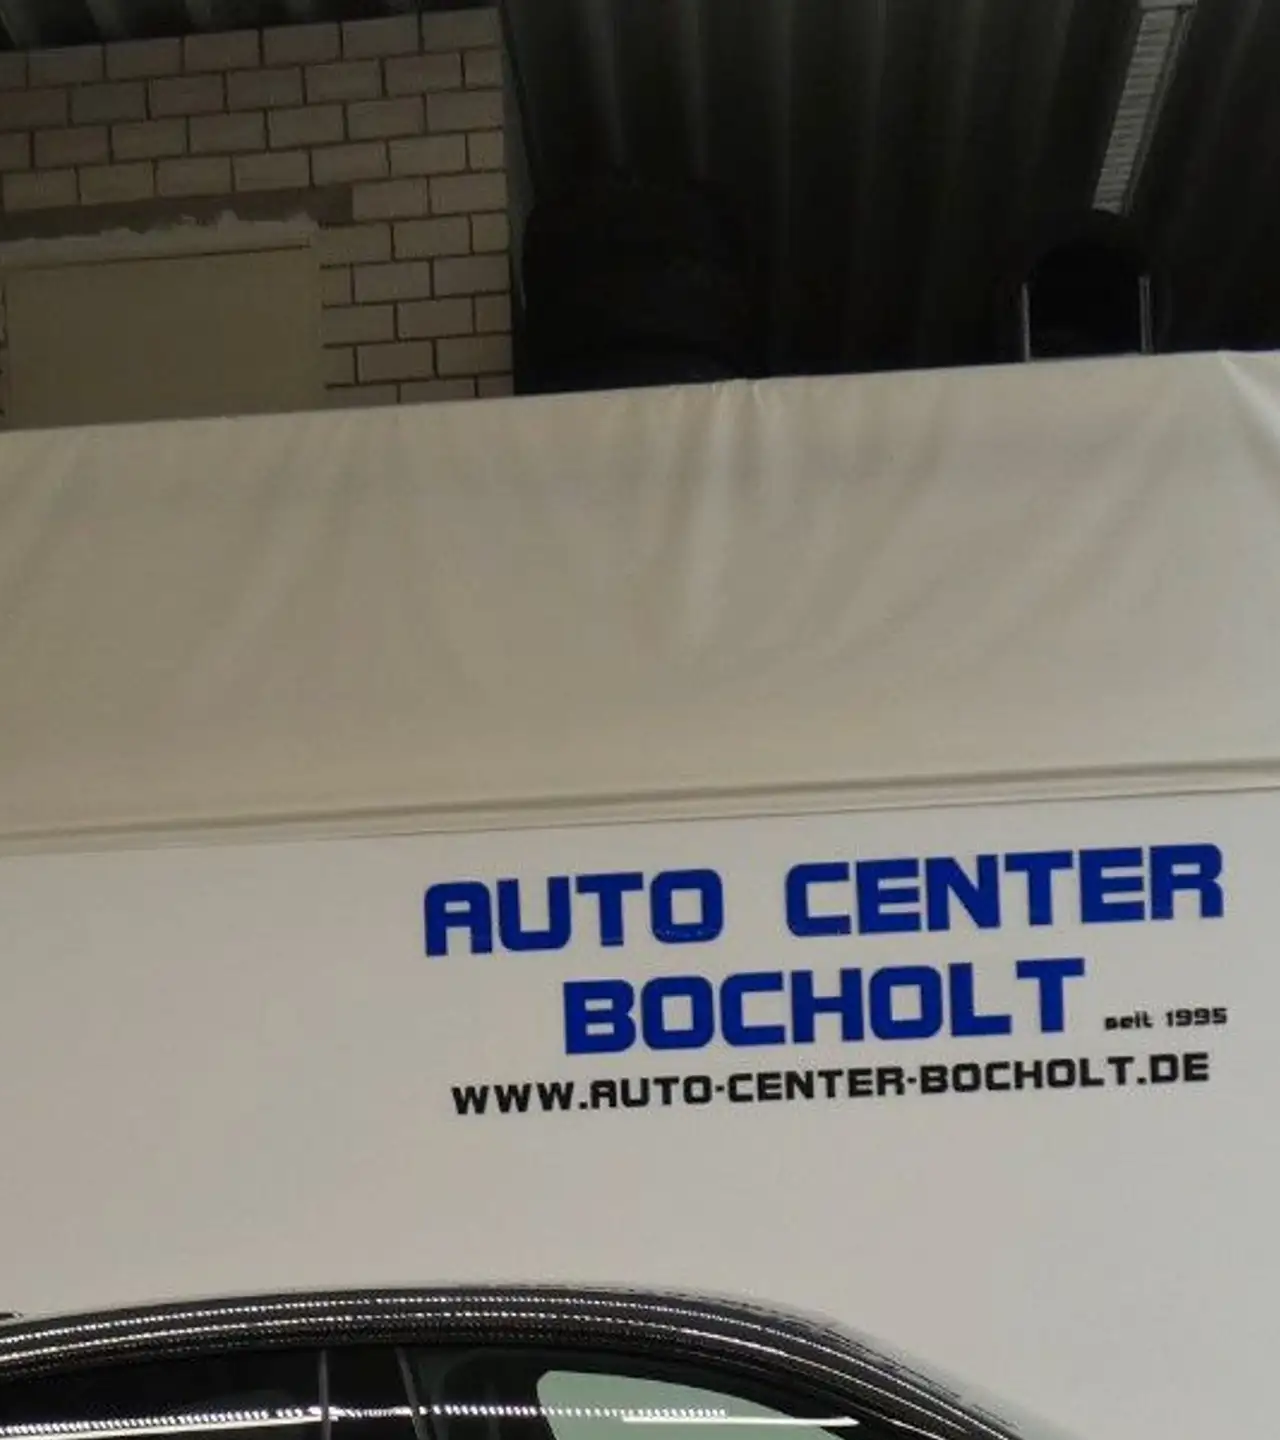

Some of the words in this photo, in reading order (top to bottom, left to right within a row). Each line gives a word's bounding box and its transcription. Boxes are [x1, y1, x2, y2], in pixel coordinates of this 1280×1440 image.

[424, 868, 726, 958] AUTO
[785, 843, 1225, 938] CENTER
[563, 956, 1086, 1056] BOCHOLT
[1104, 1010, 1154, 1031] seit
[1165, 1006, 1228, 1028] 1995
[451, 1051, 1210, 1117] WWW.AUTO-CENTER-BOCHOLT.DE
